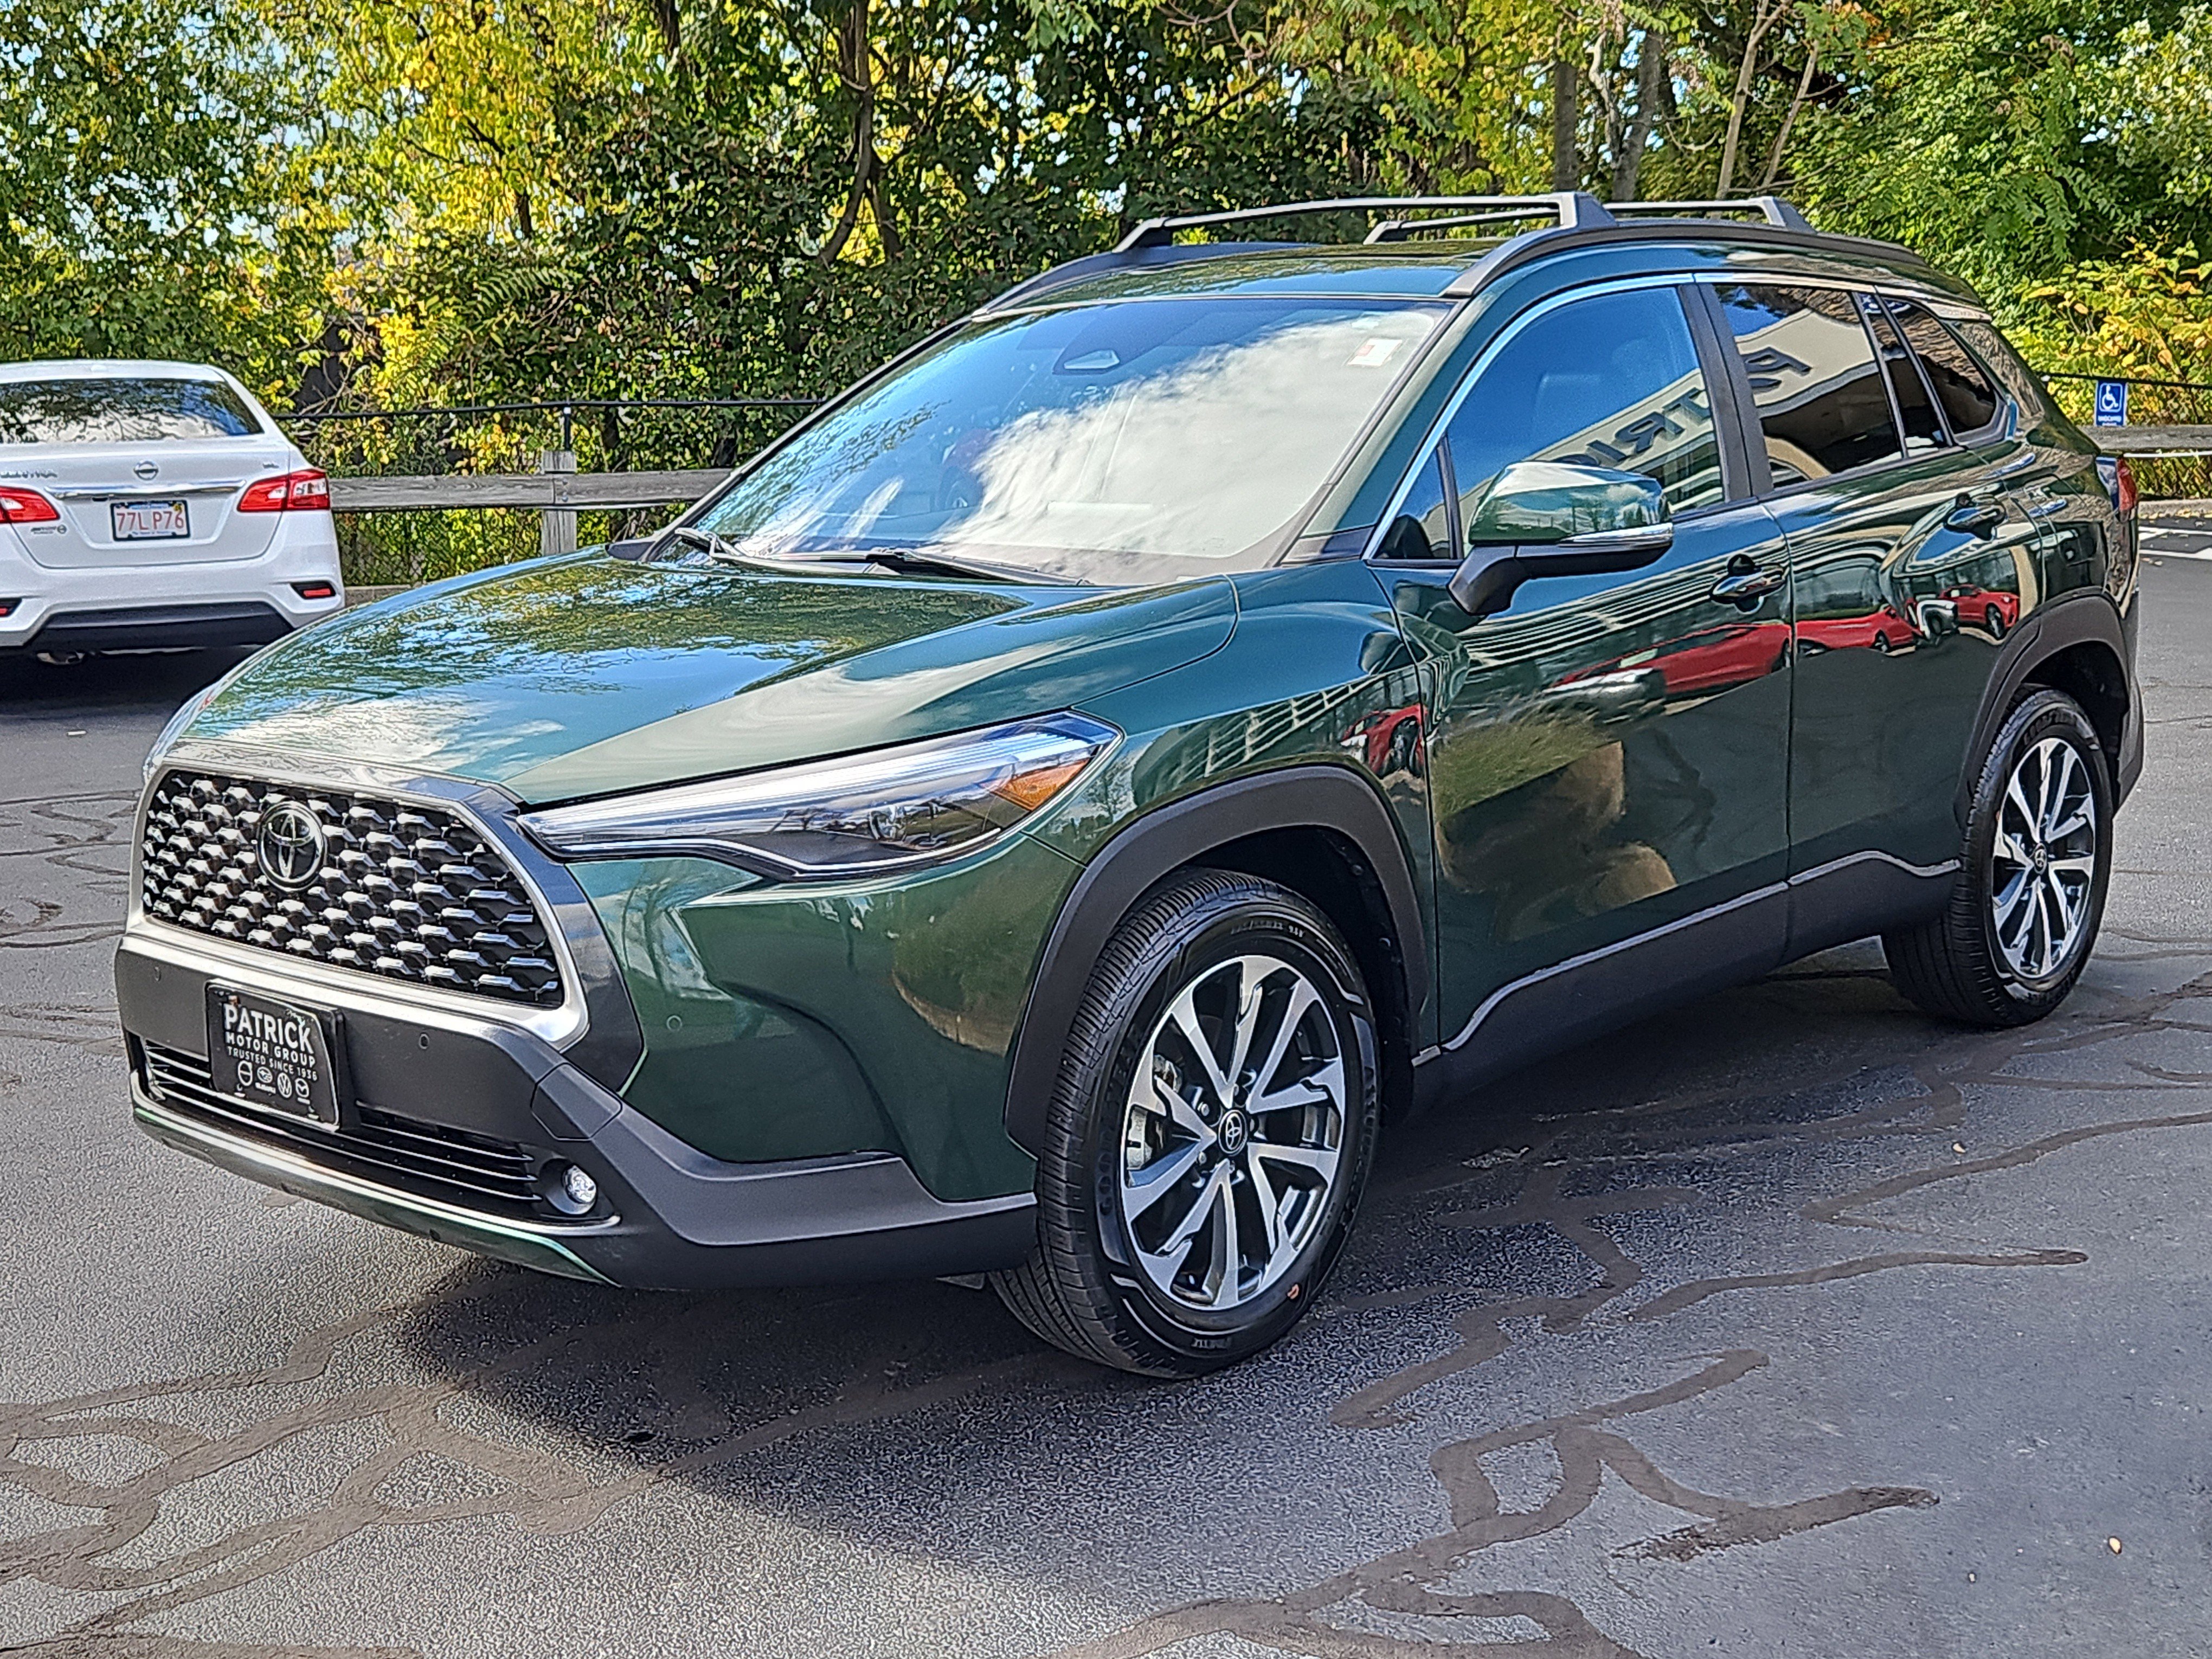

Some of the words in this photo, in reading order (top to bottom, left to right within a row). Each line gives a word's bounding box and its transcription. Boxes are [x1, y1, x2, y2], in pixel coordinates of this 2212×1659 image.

[116, 512, 149, 531] 77L
[152, 507, 184, 530] P76
[223, 1003, 314, 1054] PATRICK
[225, 1031, 269, 1054] MOTOR
[274, 1046, 316, 1068] GROUP
[227, 1046, 266, 1065] TRUSTED
[269, 1058, 294, 1075] SINCE
[297, 1066, 318, 1082] 1936
